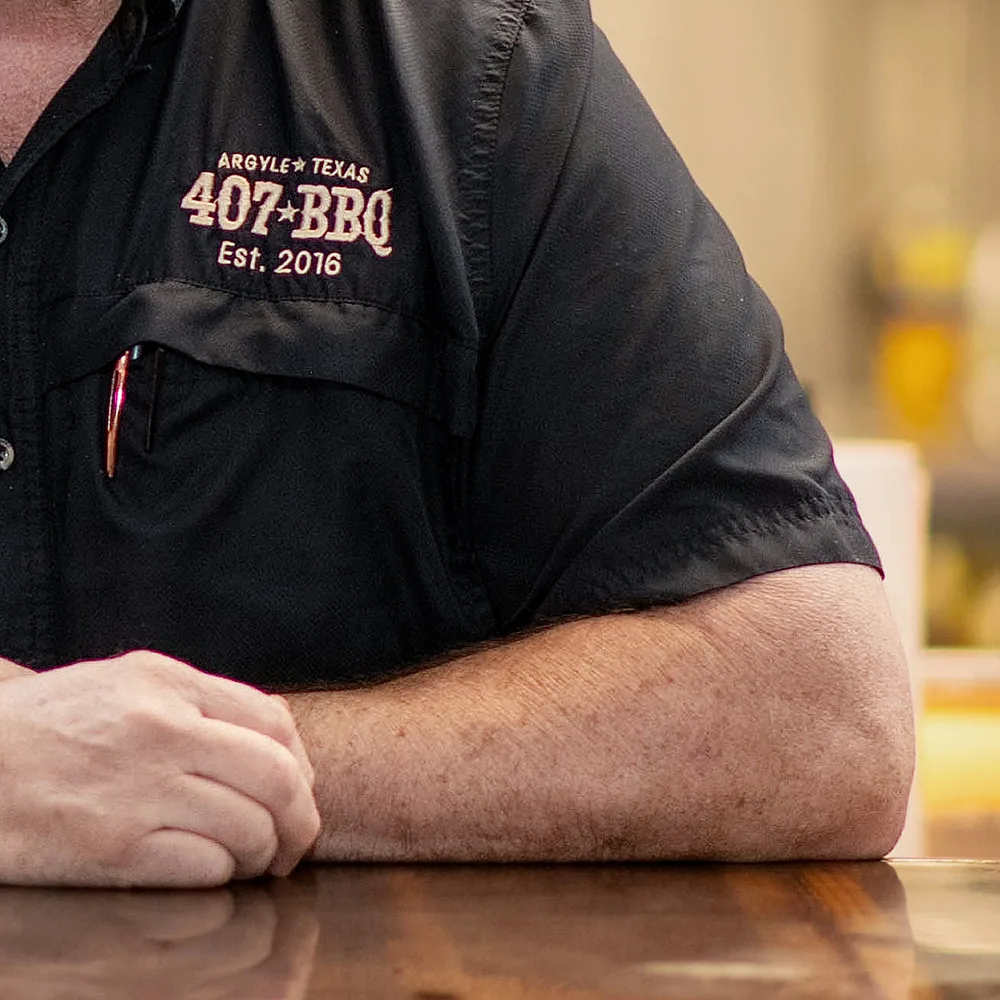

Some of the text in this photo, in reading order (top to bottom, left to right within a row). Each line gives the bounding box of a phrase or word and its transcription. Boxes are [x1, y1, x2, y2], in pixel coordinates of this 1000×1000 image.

[218, 152, 370, 184] ARGYLE TEXAS
[181, 172, 393, 257] 407 BBQ
[217, 240, 342, 276] Est. 2016
